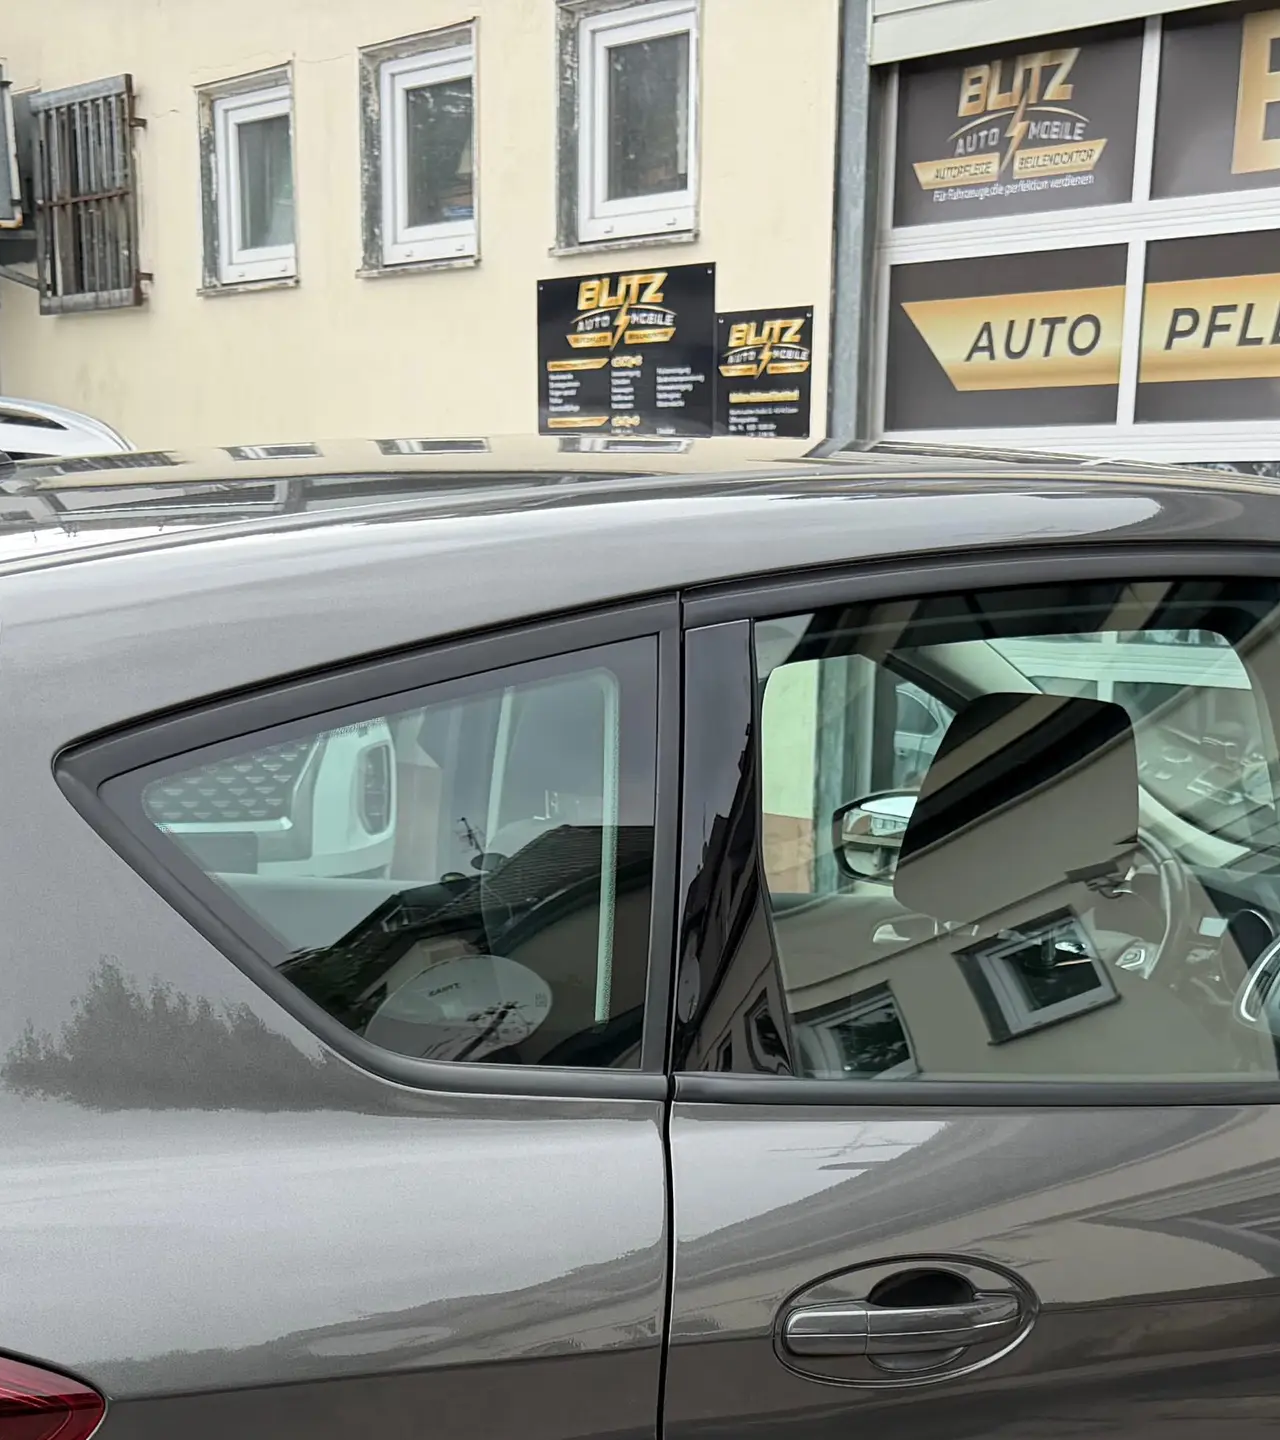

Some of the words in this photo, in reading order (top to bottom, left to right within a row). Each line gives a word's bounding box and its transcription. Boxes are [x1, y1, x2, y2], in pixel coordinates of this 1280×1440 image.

[957, 48, 1081, 117] BLITZ
[955, 128, 999, 157] AUTO
[577, 272, 668, 311] BLITZ
[576, 315, 610, 332] AUTO
[728, 319, 805, 348] BLITZ
[964, 314, 1101, 363] AUTO
